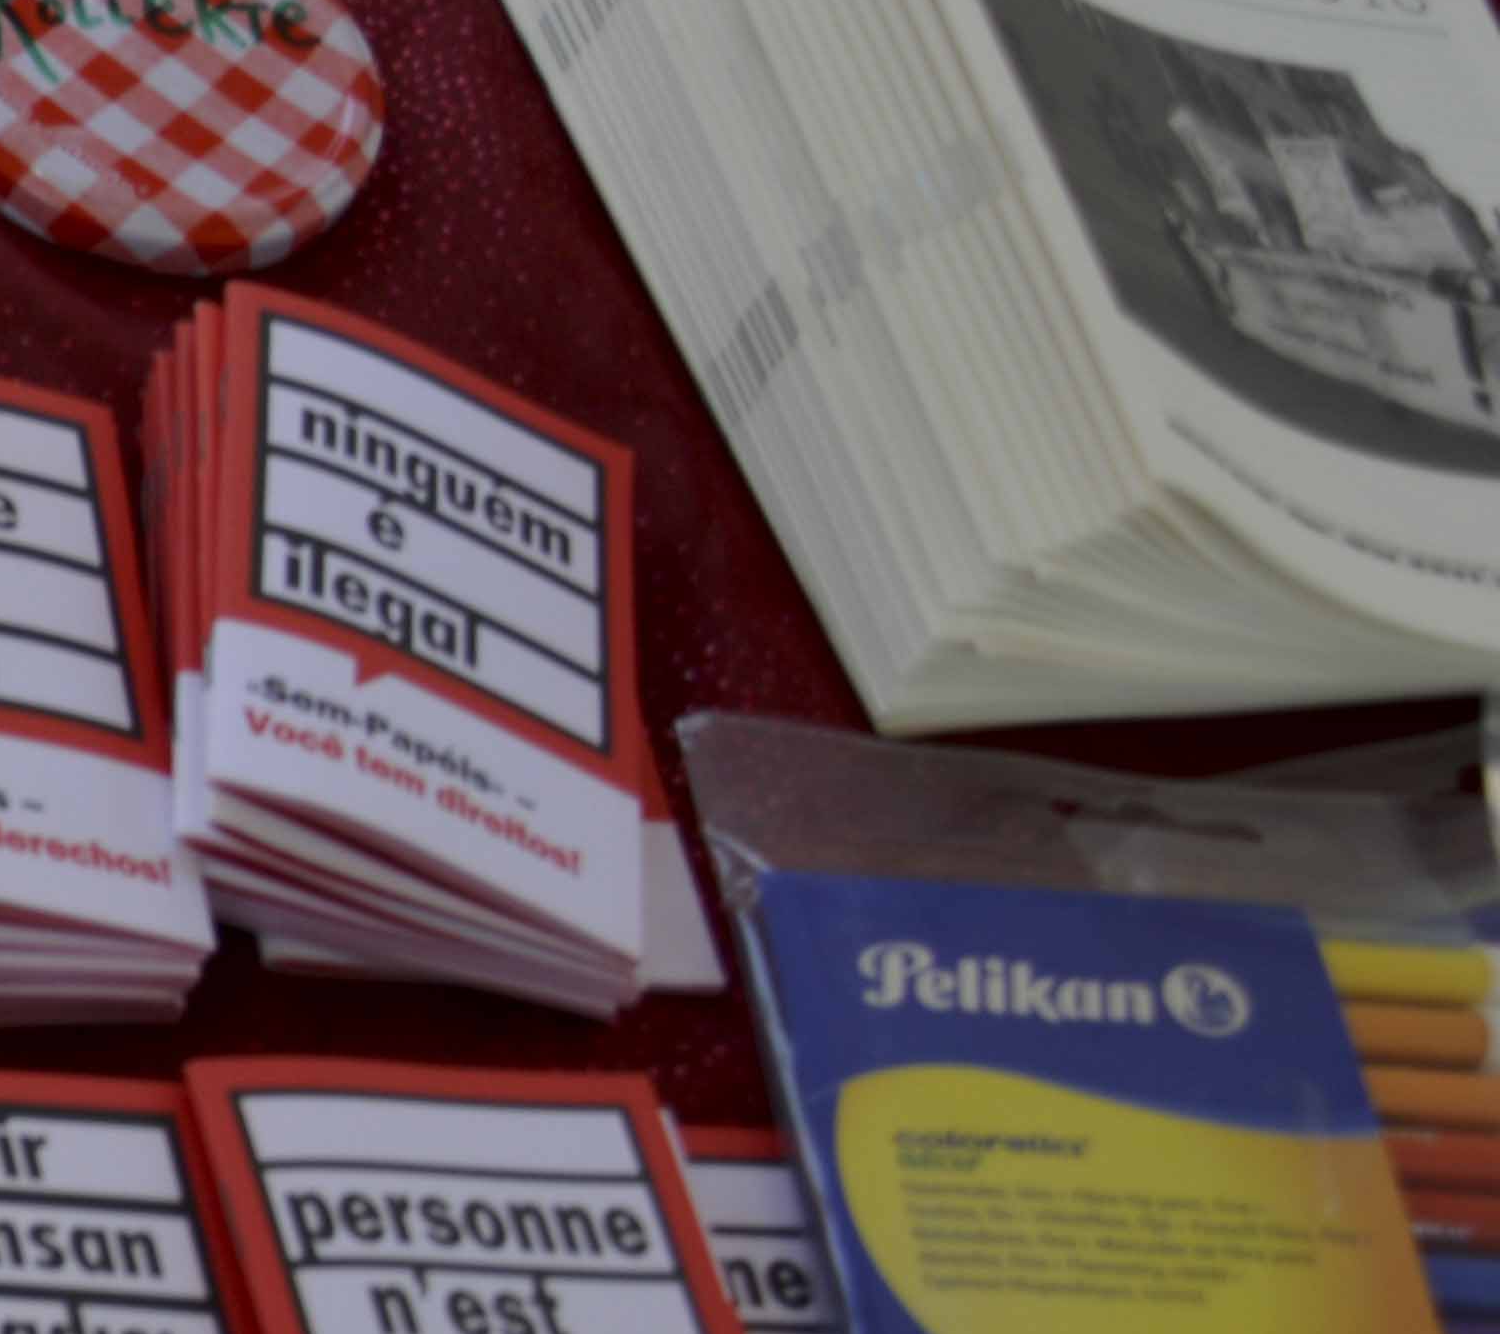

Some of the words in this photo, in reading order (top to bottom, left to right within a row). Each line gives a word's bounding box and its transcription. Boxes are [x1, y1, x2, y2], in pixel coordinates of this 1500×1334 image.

[286, 540, 480, 669] ilegal
[243, 708, 348, 765] Você
[355, 748, 427, 797] tem
[436, 781, 583, 879] direitos!
[857, 939, 1156, 1025] Pelikan
[285, 1189, 650, 1264] personne
